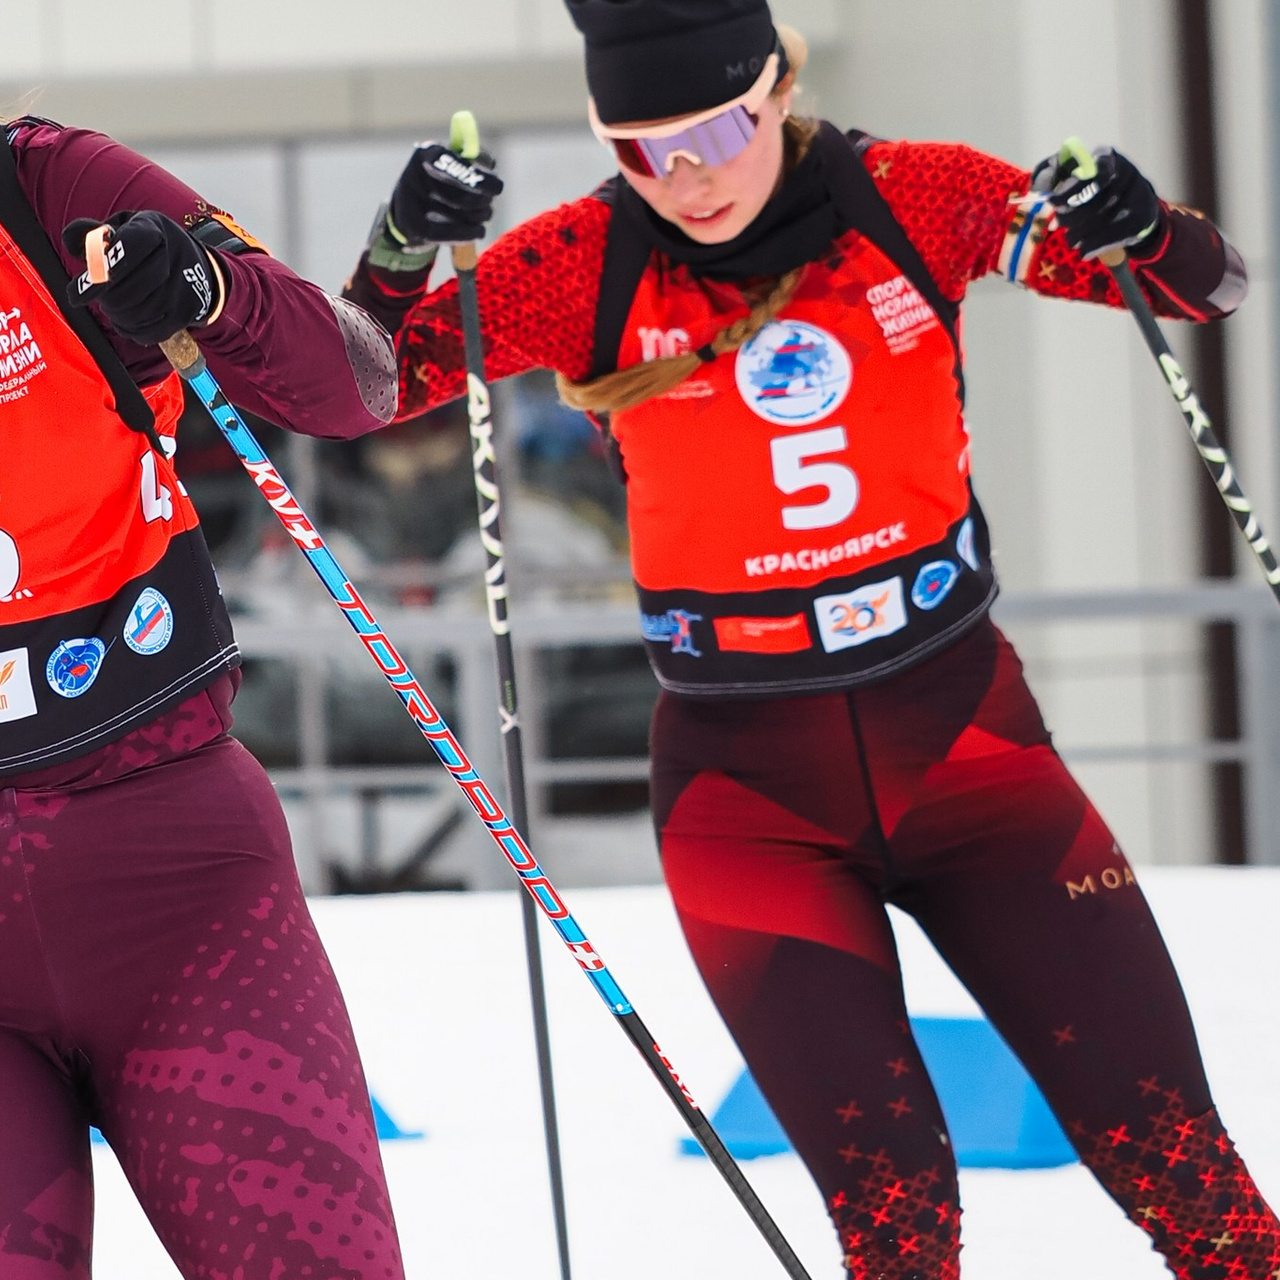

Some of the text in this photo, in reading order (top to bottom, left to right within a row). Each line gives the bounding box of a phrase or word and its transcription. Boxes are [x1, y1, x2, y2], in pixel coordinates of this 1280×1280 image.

[770, 426, 859, 530] 5
[744, 522, 908, 577] КРАСНОЯРСК
[334, 581, 570, 920] TORNADO
